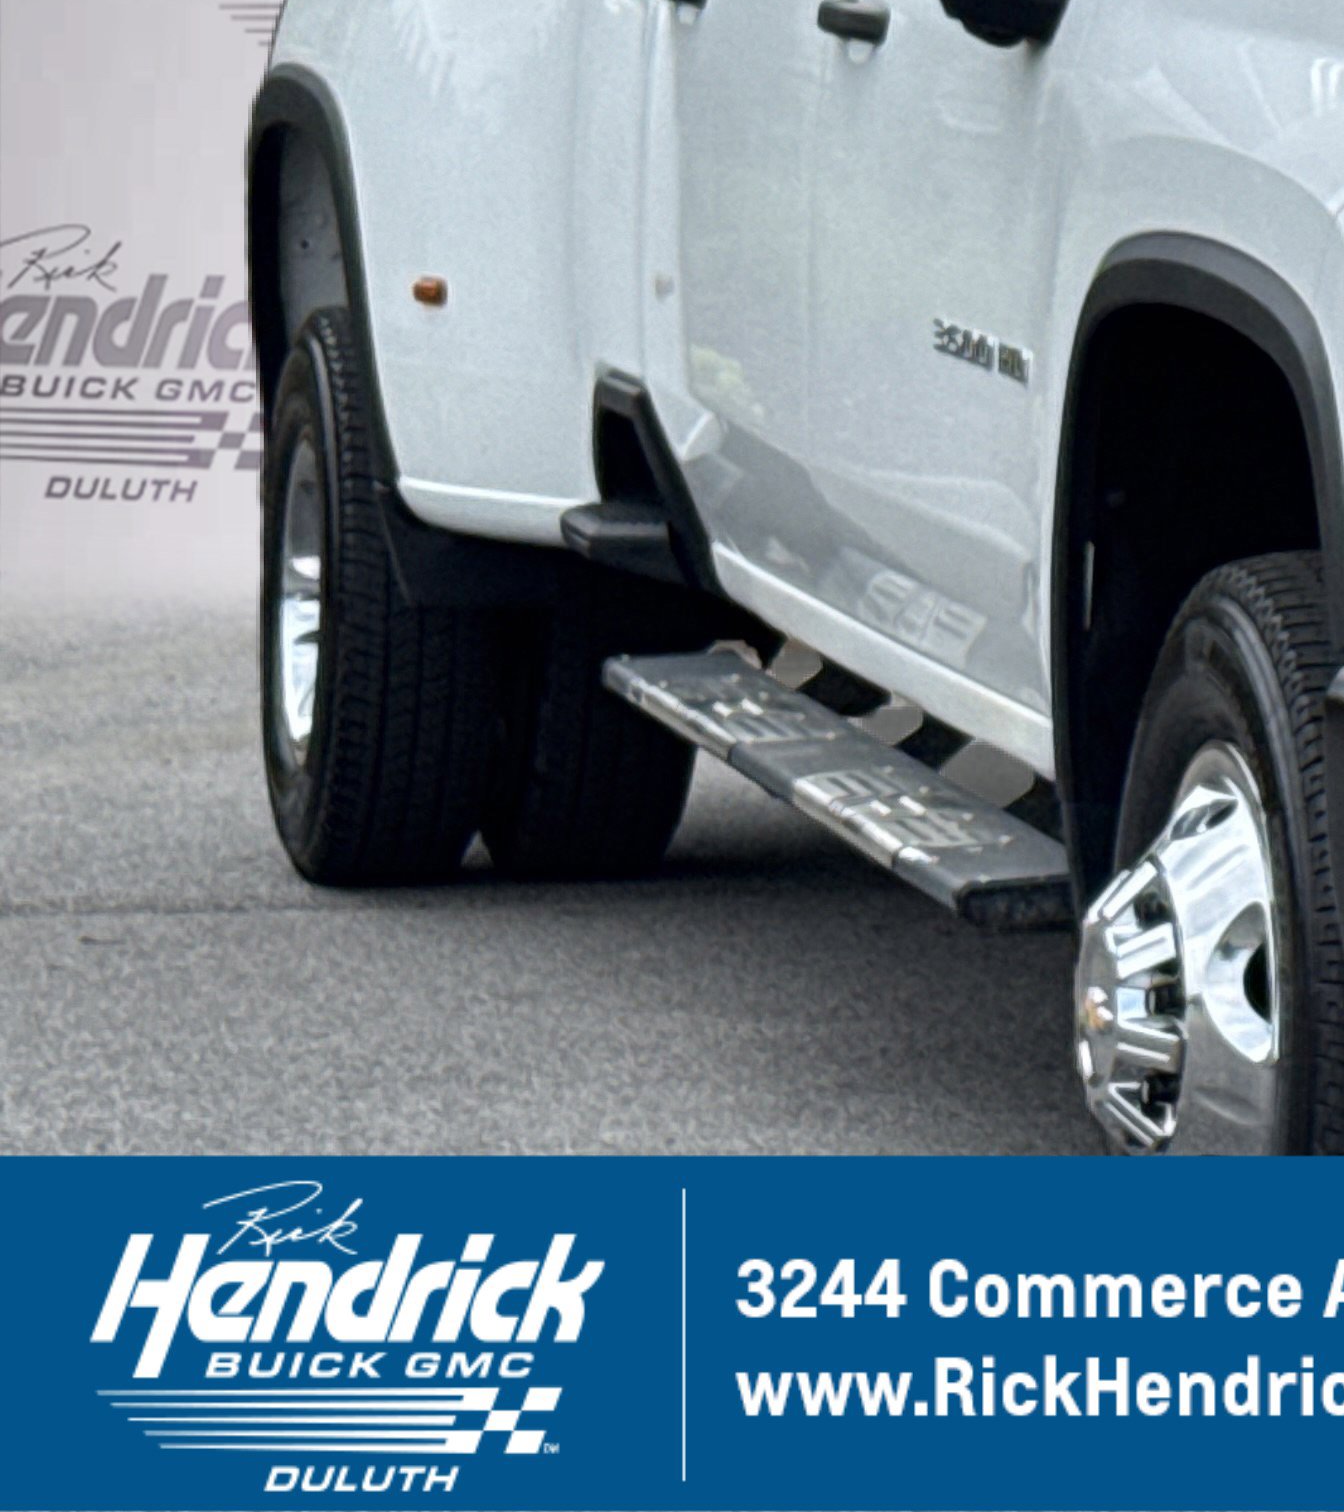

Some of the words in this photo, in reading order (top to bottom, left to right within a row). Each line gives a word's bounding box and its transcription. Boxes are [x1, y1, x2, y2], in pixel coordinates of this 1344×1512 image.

[0, 273, 255, 371] endric
[0, 374, 139, 401] BUICK
[154, 378, 256, 404] GMC
[45, 476, 198, 503] DULUTH
